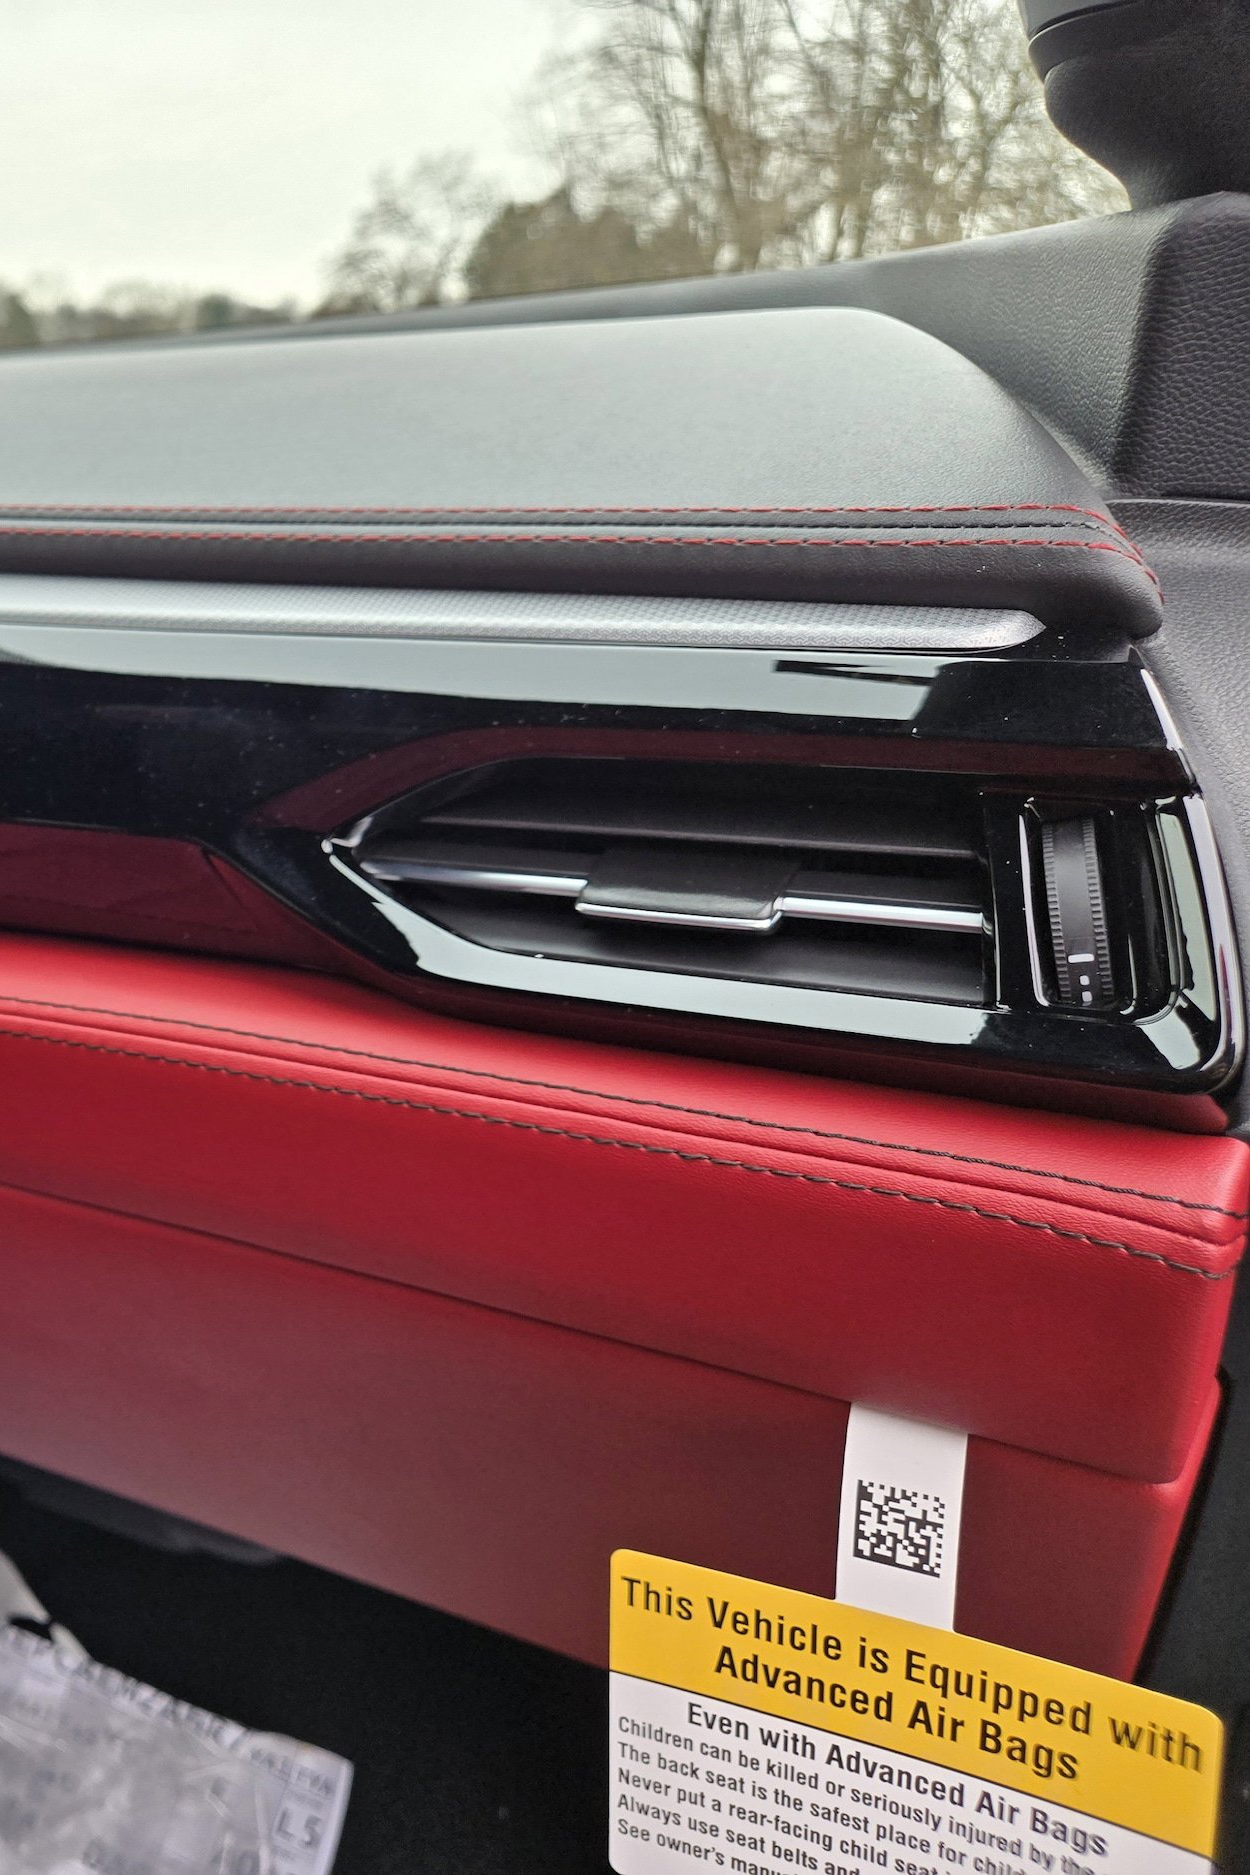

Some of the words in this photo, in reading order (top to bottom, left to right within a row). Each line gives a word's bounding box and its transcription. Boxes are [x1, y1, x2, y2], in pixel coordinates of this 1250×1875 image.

[621, 1576, 693, 1621] This
[707, 1597, 842, 1661] Vehicle
[859, 1636, 890, 1674] is
[904, 1649, 1092, 1735] Equipped
[1108, 1715, 1203, 1774] with
[715, 1645, 893, 1723] Advanced
[907, 1699, 965, 1742] Air
[978, 1718, 1079, 1780] Bags
[617, 1741, 650, 1764] The
[657, 1752, 700, 1780] back
[705, 1769, 745, 1794] seat
[751, 1780, 768, 1800] is
[774, 1788, 803, 1812] the
[809, 1802, 870, 1834] safest
[876, 1823, 931, 1854] place
[938, 1840, 968, 1866] for
[617, 1793, 682, 1826] Always
[688, 1816, 720, 1837] use
[725, 1829, 765, 1854] seat
[771, 1840, 818, 1871] belts
[617, 1818, 650, 1842] See
[656, 1832, 725, 1866] owner's
[618, 1716, 693, 1751] Children
[700, 1742, 732, 1763] can
[738, 1750, 760, 1771] be
[766, 1758, 819, 1790] killed
[826, 1780, 846, 1798] or
[850, 1787, 942, 1832] seriously
[948, 1815, 1023, 1857] injured
[1029, 1842, 1054, 1871] by
[618, 1767, 671, 1797] Never
[677, 1788, 706, 1808] put
[711, 1798, 722, 1813] a
[729, 1802, 833, 1852] rear-facing
[840, 1839, 888, 1868] child
[687, 1702, 750, 1740] Even
[759, 1727, 816, 1760] with
[825, 1743, 965, 1808] Advanced
[974, 1790, 1021, 1825] Air
[1030, 1806, 1109, 1856] Bags
